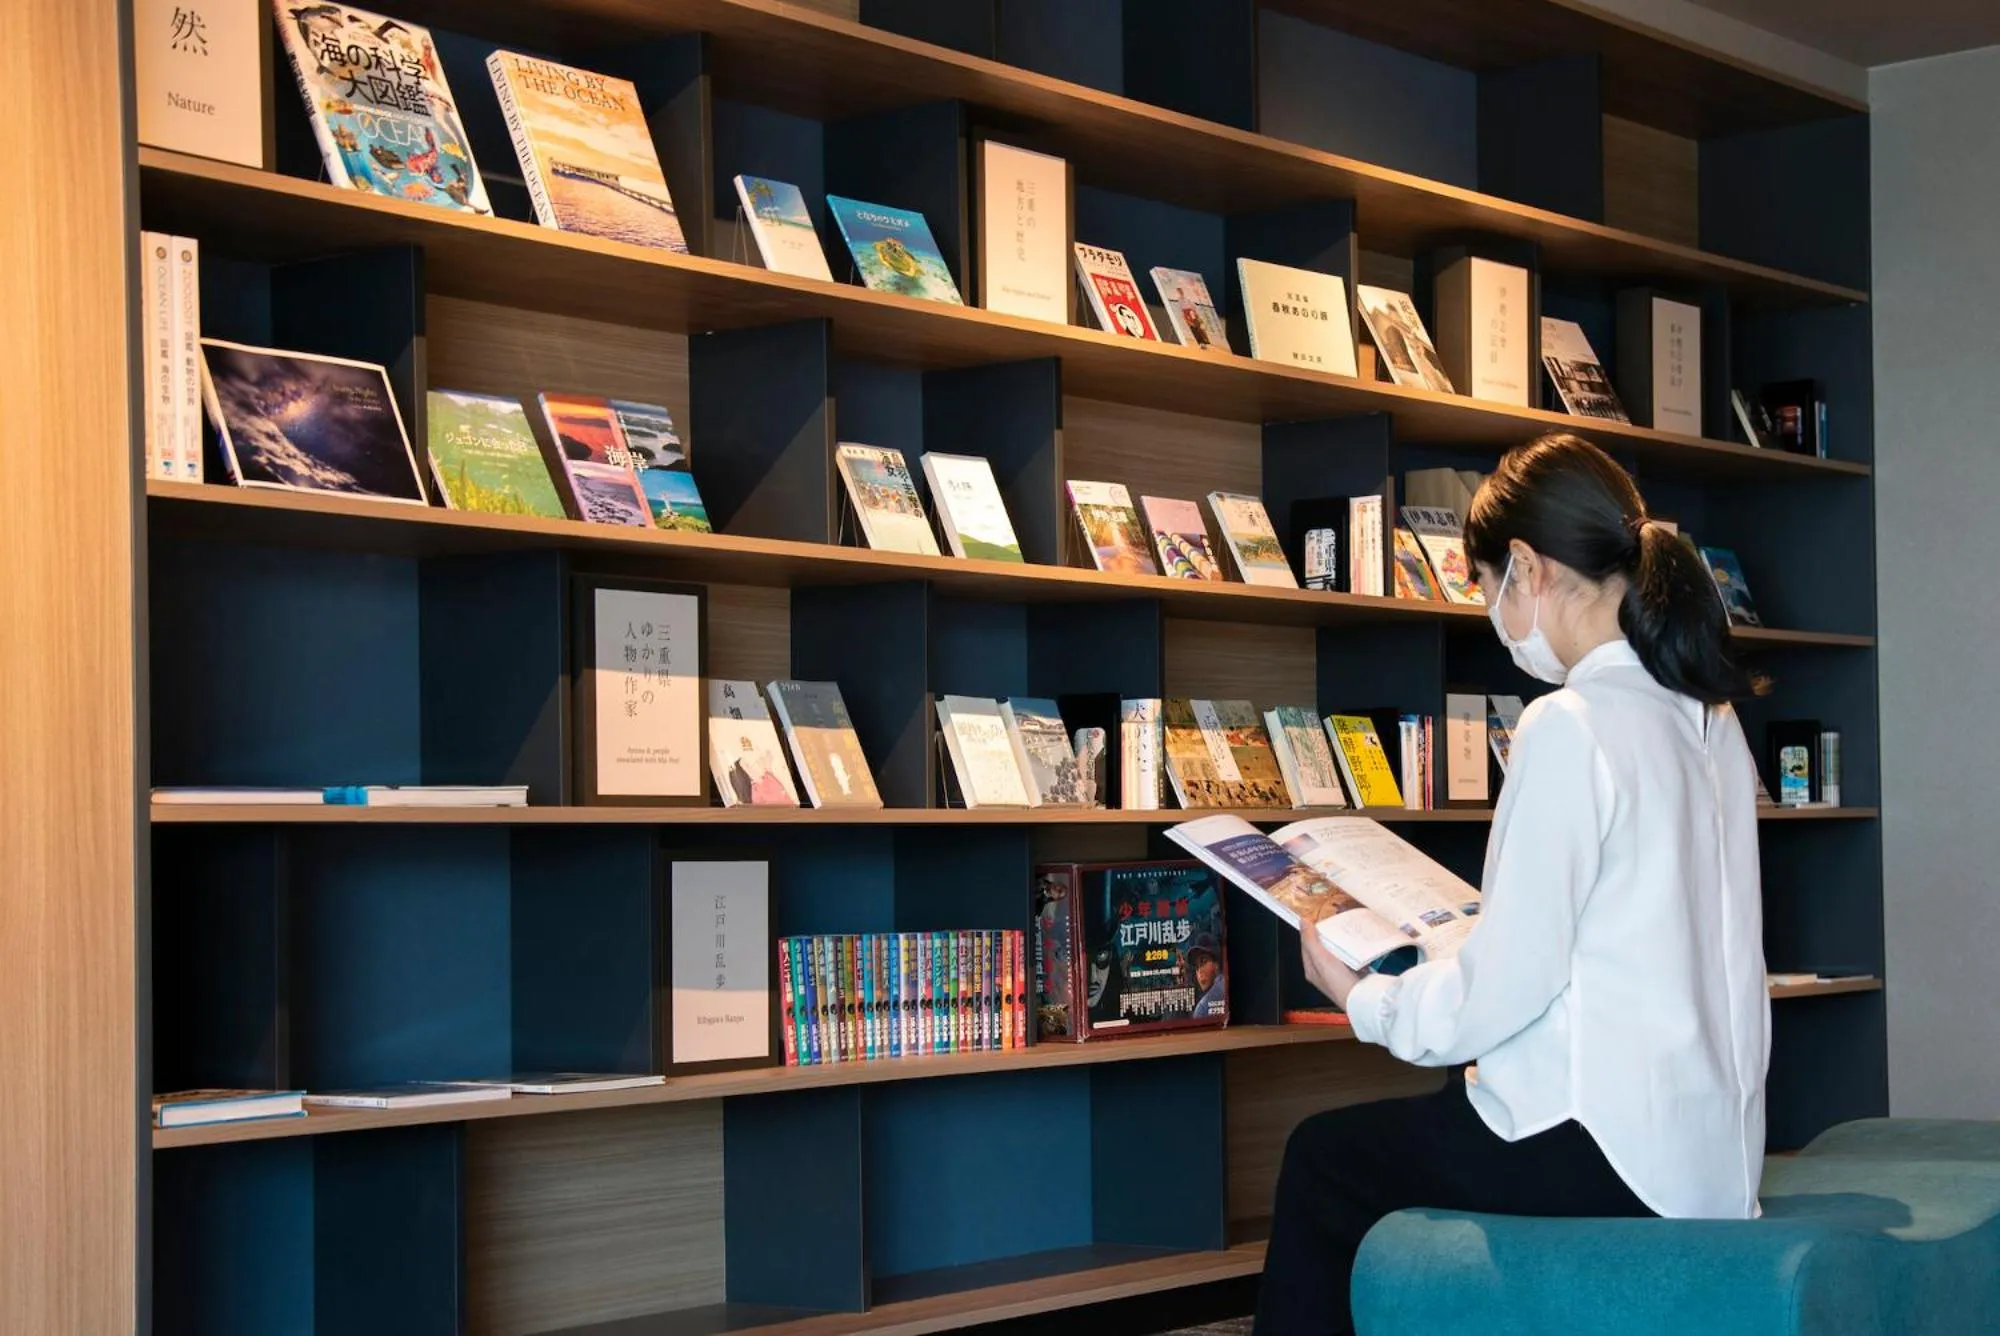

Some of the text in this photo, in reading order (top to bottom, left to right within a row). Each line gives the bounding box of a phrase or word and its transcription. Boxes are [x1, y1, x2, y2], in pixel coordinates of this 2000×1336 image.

[170, 6, 210, 57] 然
[310, 31, 430, 86] 海の科学
[515, 58, 606, 92] LIVING BY
[166, 91, 215, 117] Nature
[338, 69, 432, 117] 大図鑑
[518, 75, 626, 112] THE OCEAN
[490, 57, 550, 223] LIVING BY THE OCEAN
[604, 444, 649, 473] 海岸
[623, 621, 639, 718] 人物・作家
[640, 621, 655, 706] ゆかりの
[657, 623, 672, 689] 三重県
[714, 894, 727, 991] 江戸川乱歩
[1119, 918, 1192, 947] 江戸川乱歩
